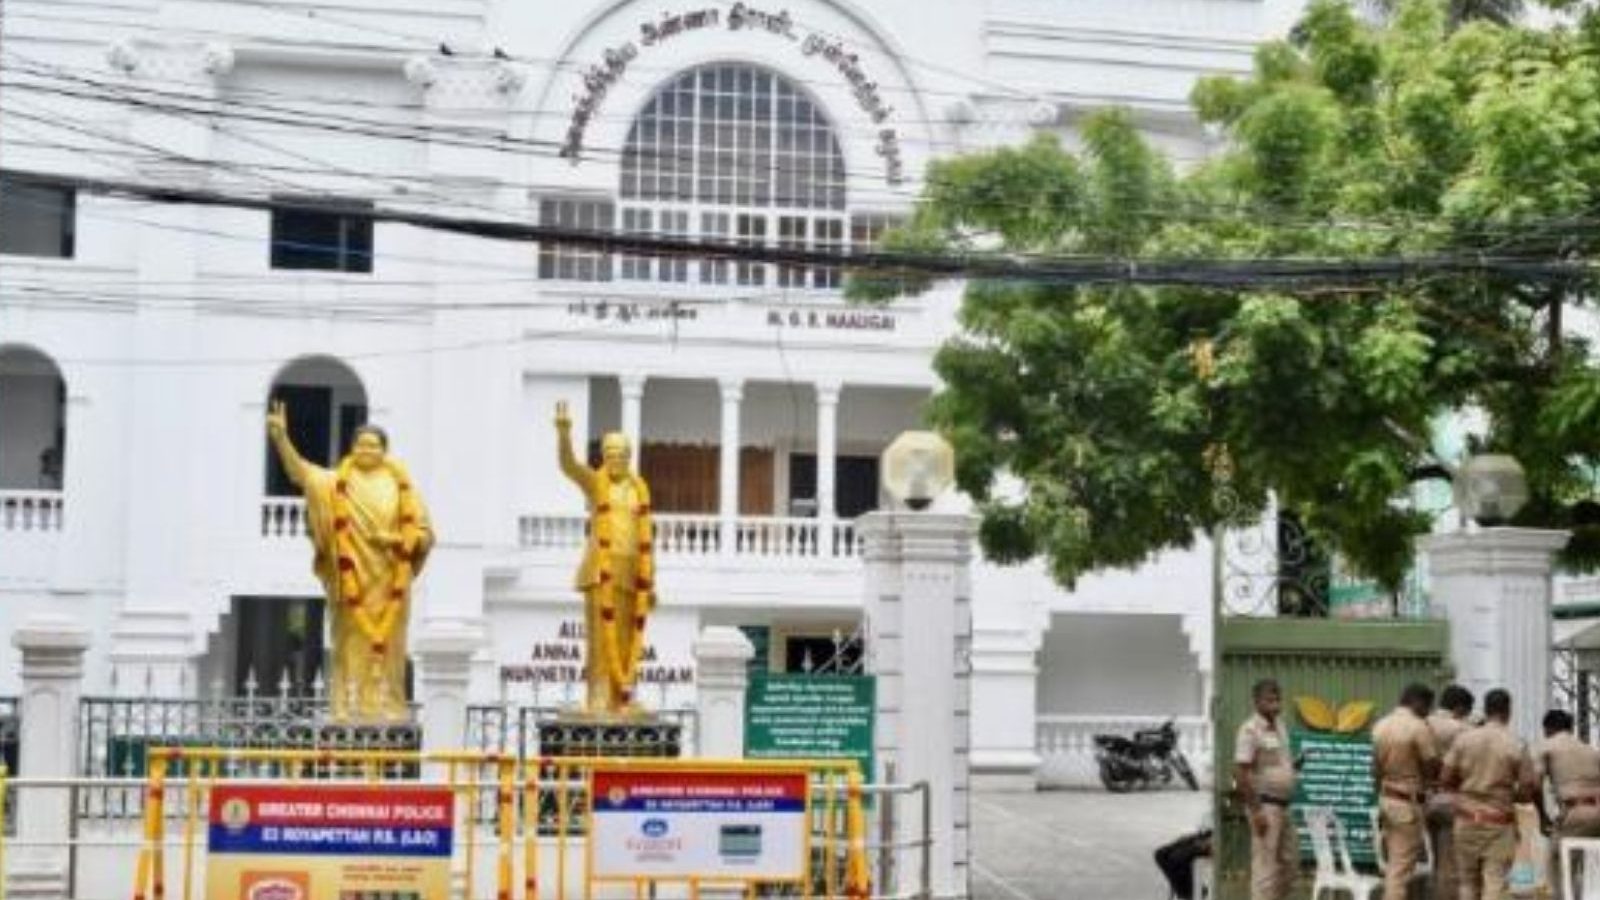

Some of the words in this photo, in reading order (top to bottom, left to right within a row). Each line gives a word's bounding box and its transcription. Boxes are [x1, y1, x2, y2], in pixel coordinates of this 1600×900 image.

[532, 644, 580, 661] ANNA
[258, 802, 323, 817] GREATER
[326, 803, 389, 819] CHENNAI
[392, 805, 443, 819] POLICE
